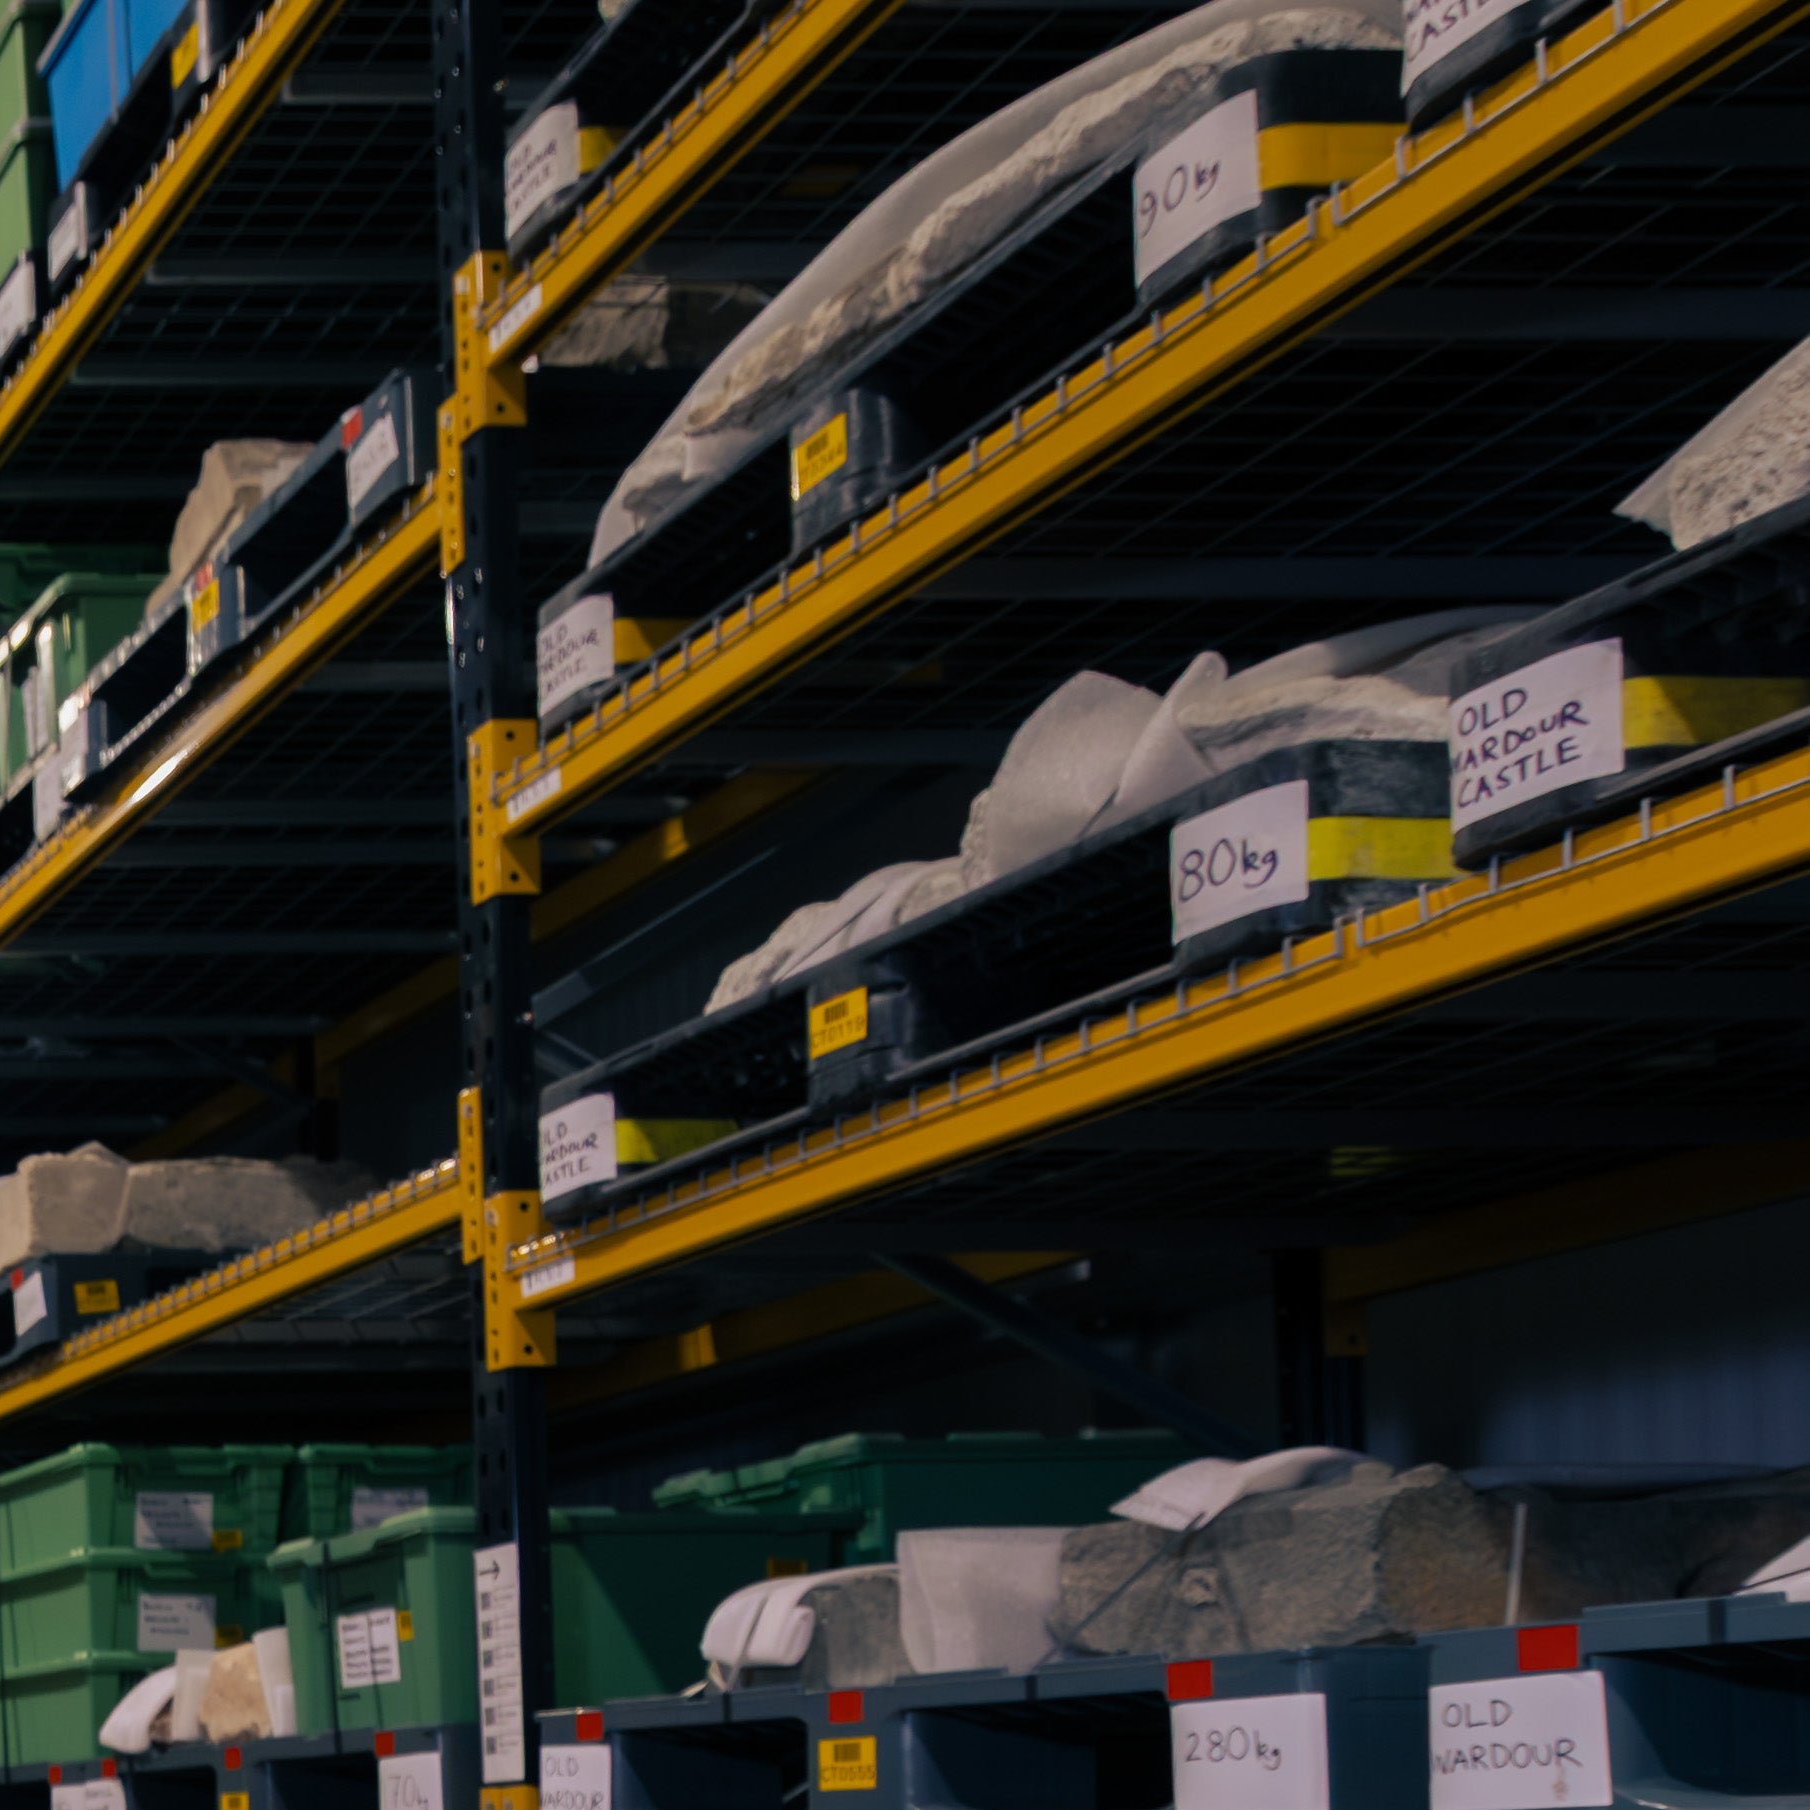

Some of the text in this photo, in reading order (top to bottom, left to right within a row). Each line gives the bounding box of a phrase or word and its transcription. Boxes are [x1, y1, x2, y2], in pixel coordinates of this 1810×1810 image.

[1138, 160, 1222, 238] 90kg
[1458, 688, 1528, 736] OLD
[1457, 736, 1582, 809] CASTLE
[1179, 837, 1280, 903] 80kg
[545, 1132, 599, 1165] ARDOUR
[544, 1155, 591, 1188] ASTLE
[1442, 1699, 1512, 1728] OLD
[1184, 1726, 1281, 1771] 280kg
[1434, 1738, 1582, 1775] WARDOUR
